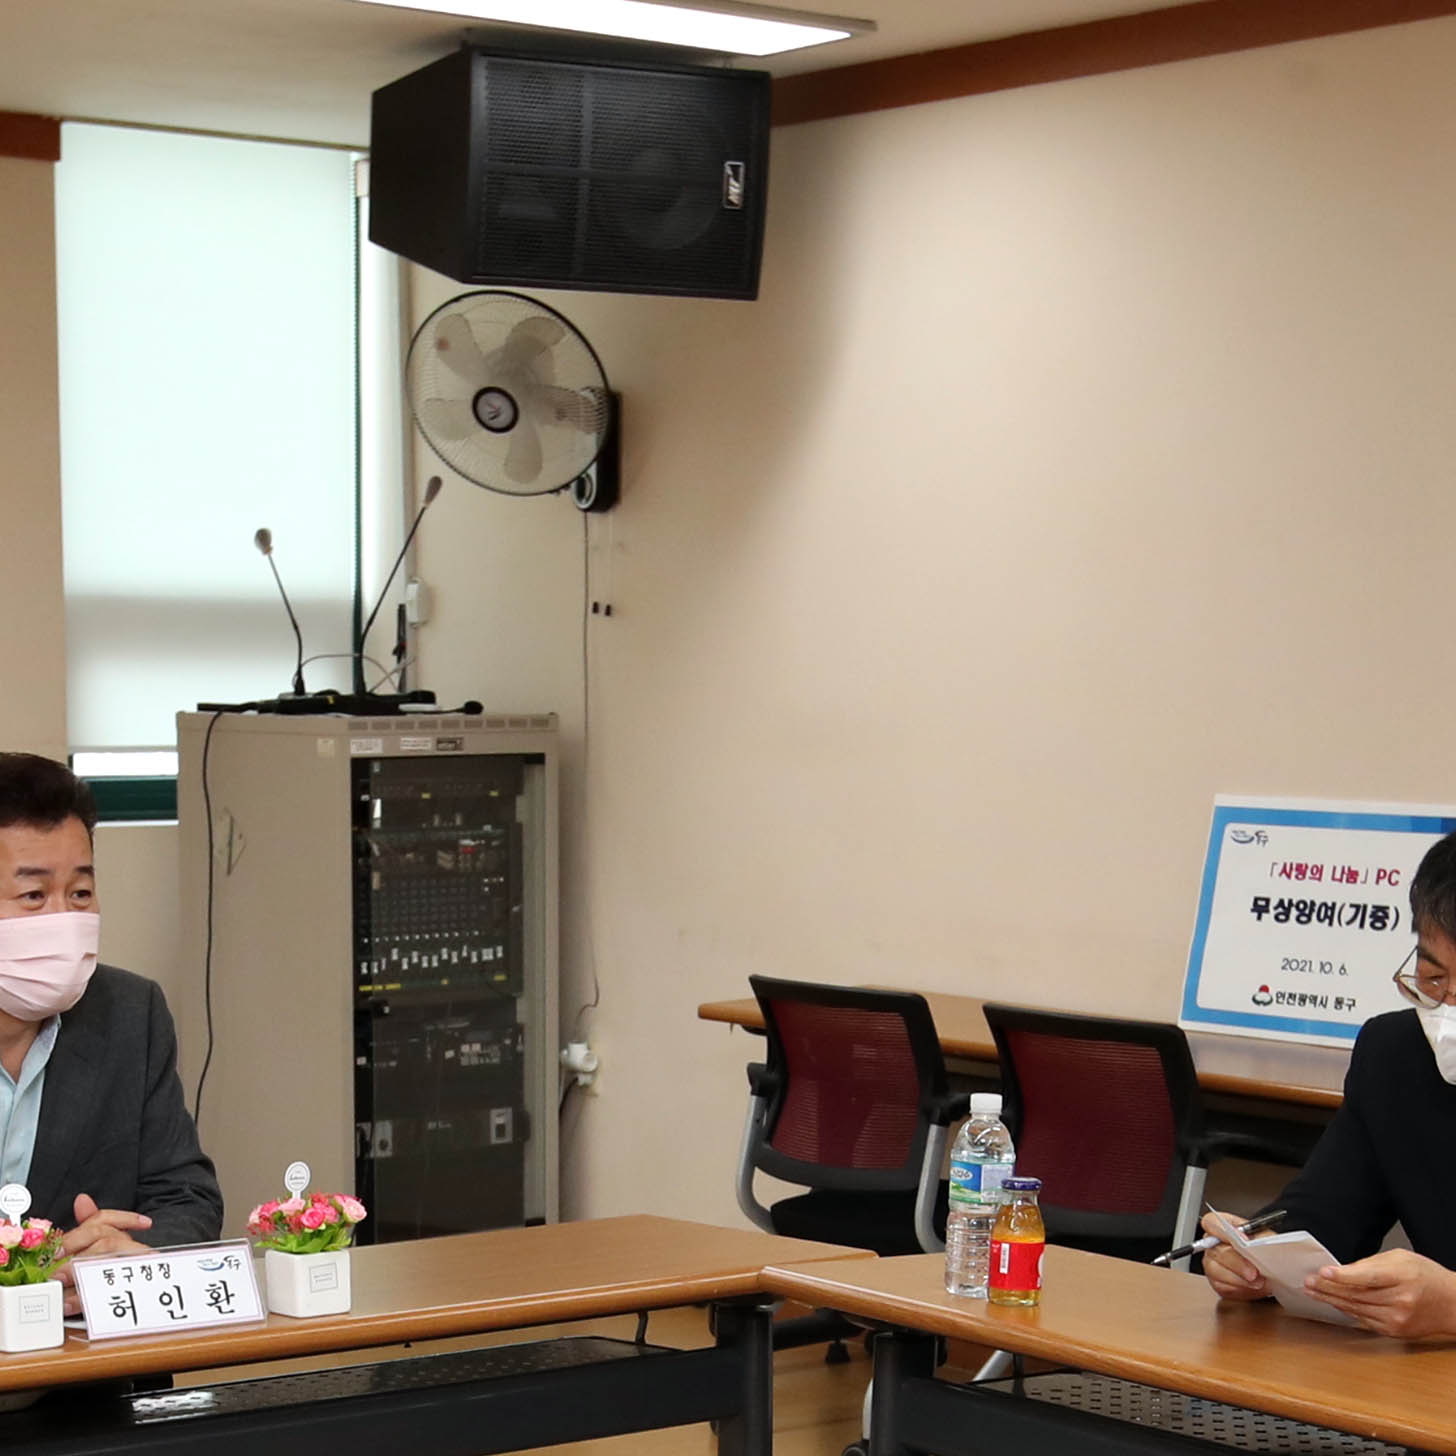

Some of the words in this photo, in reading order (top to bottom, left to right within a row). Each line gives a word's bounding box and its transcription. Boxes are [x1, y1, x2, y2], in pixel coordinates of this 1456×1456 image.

[1375, 868, 1401, 886] PC
[1250, 896, 1401, 931] 무상양여(기증)
[1334, 996, 1357, 1012] 동구
